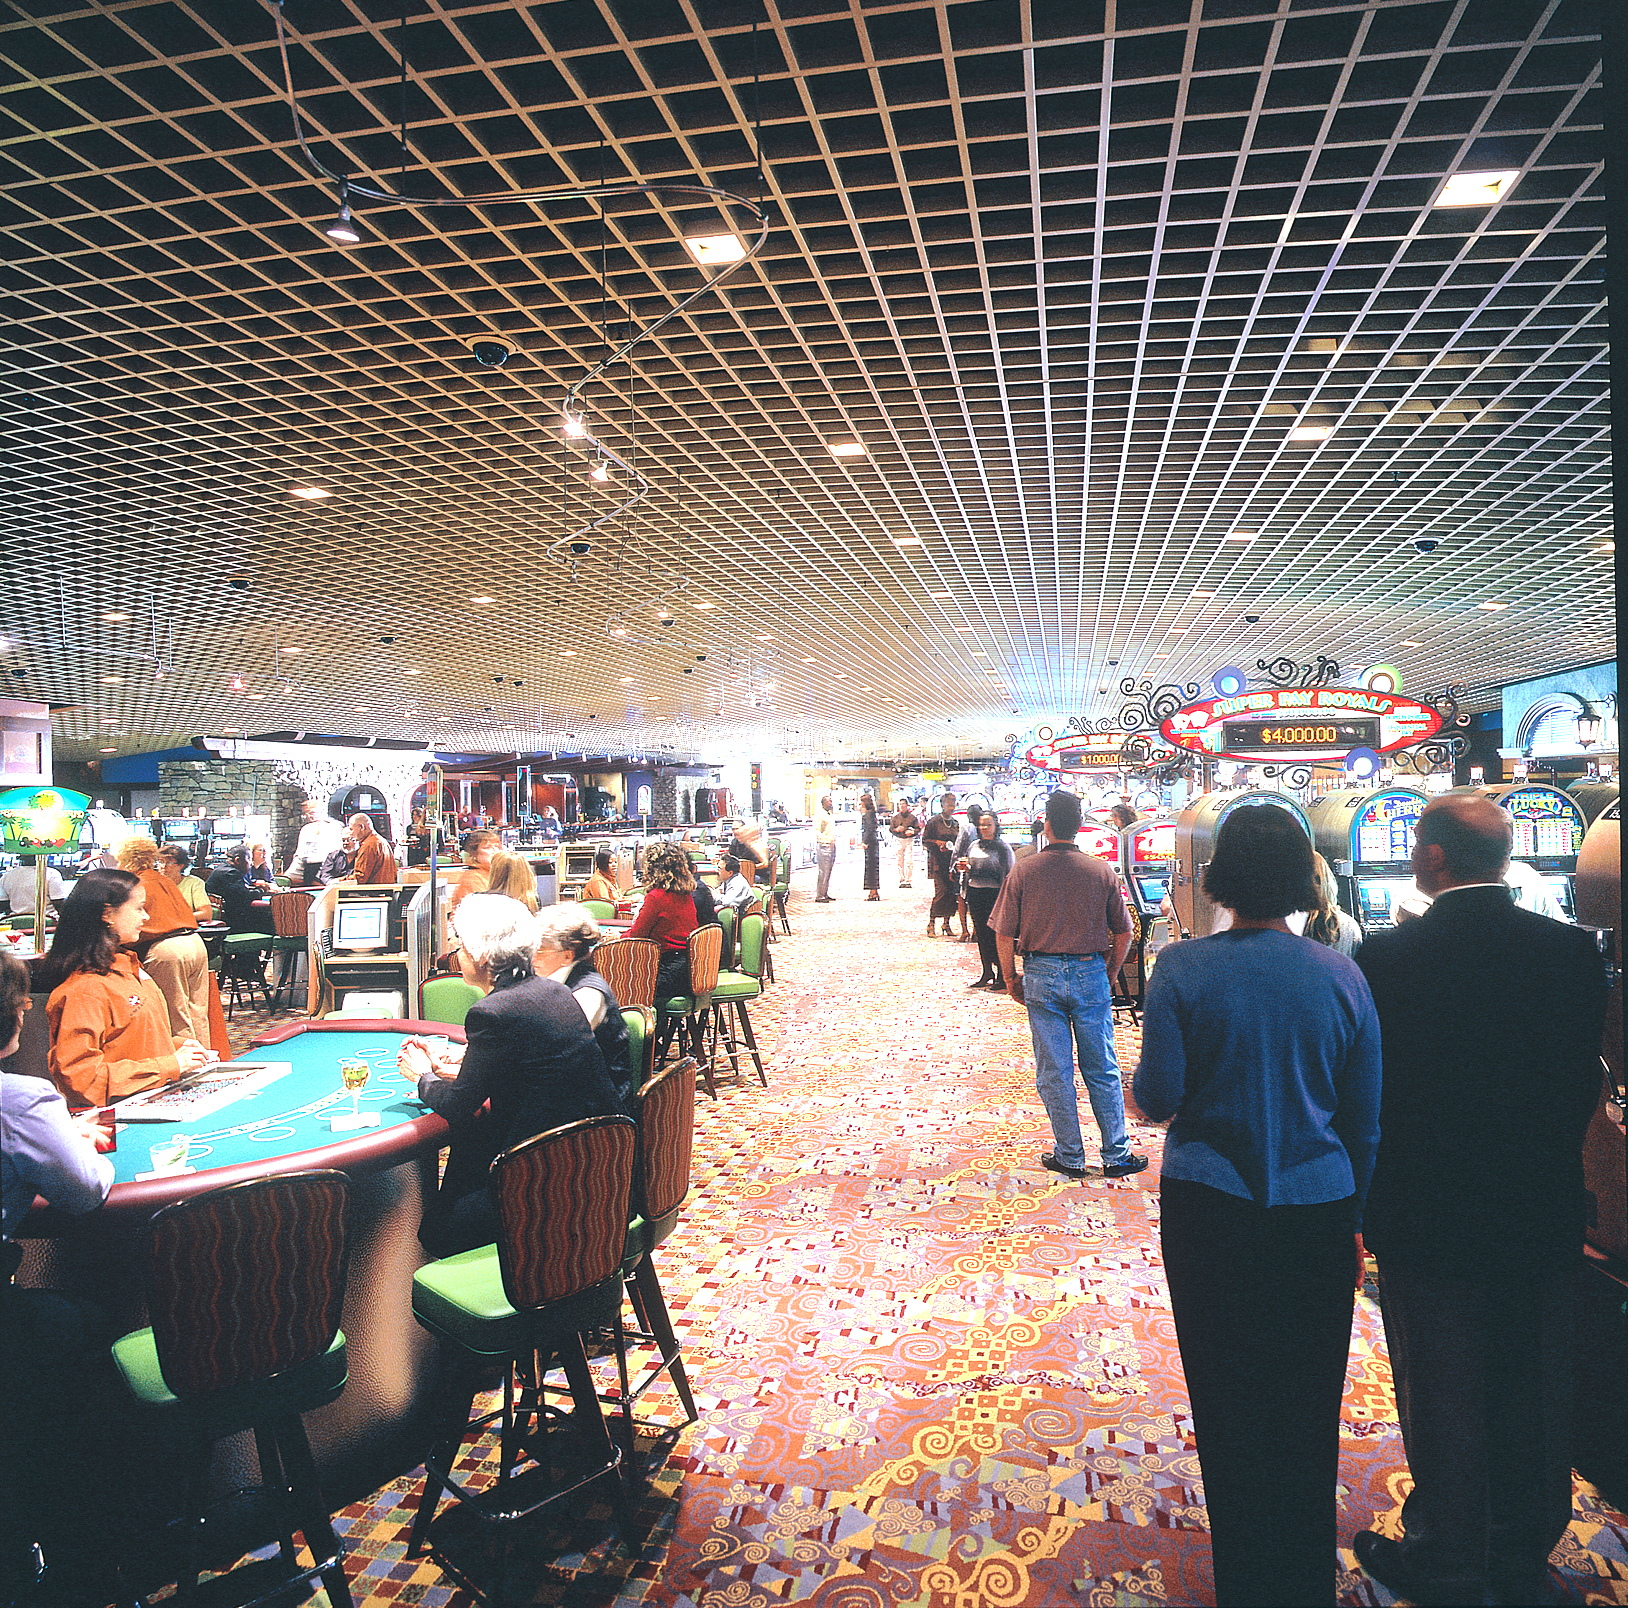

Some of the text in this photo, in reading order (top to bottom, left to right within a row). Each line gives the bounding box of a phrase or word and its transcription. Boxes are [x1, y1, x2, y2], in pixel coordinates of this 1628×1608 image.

[1211, 690, 1393, 719] SUPER PAY ROYALS
[1261, 726, 1337, 744] $4,000.00
